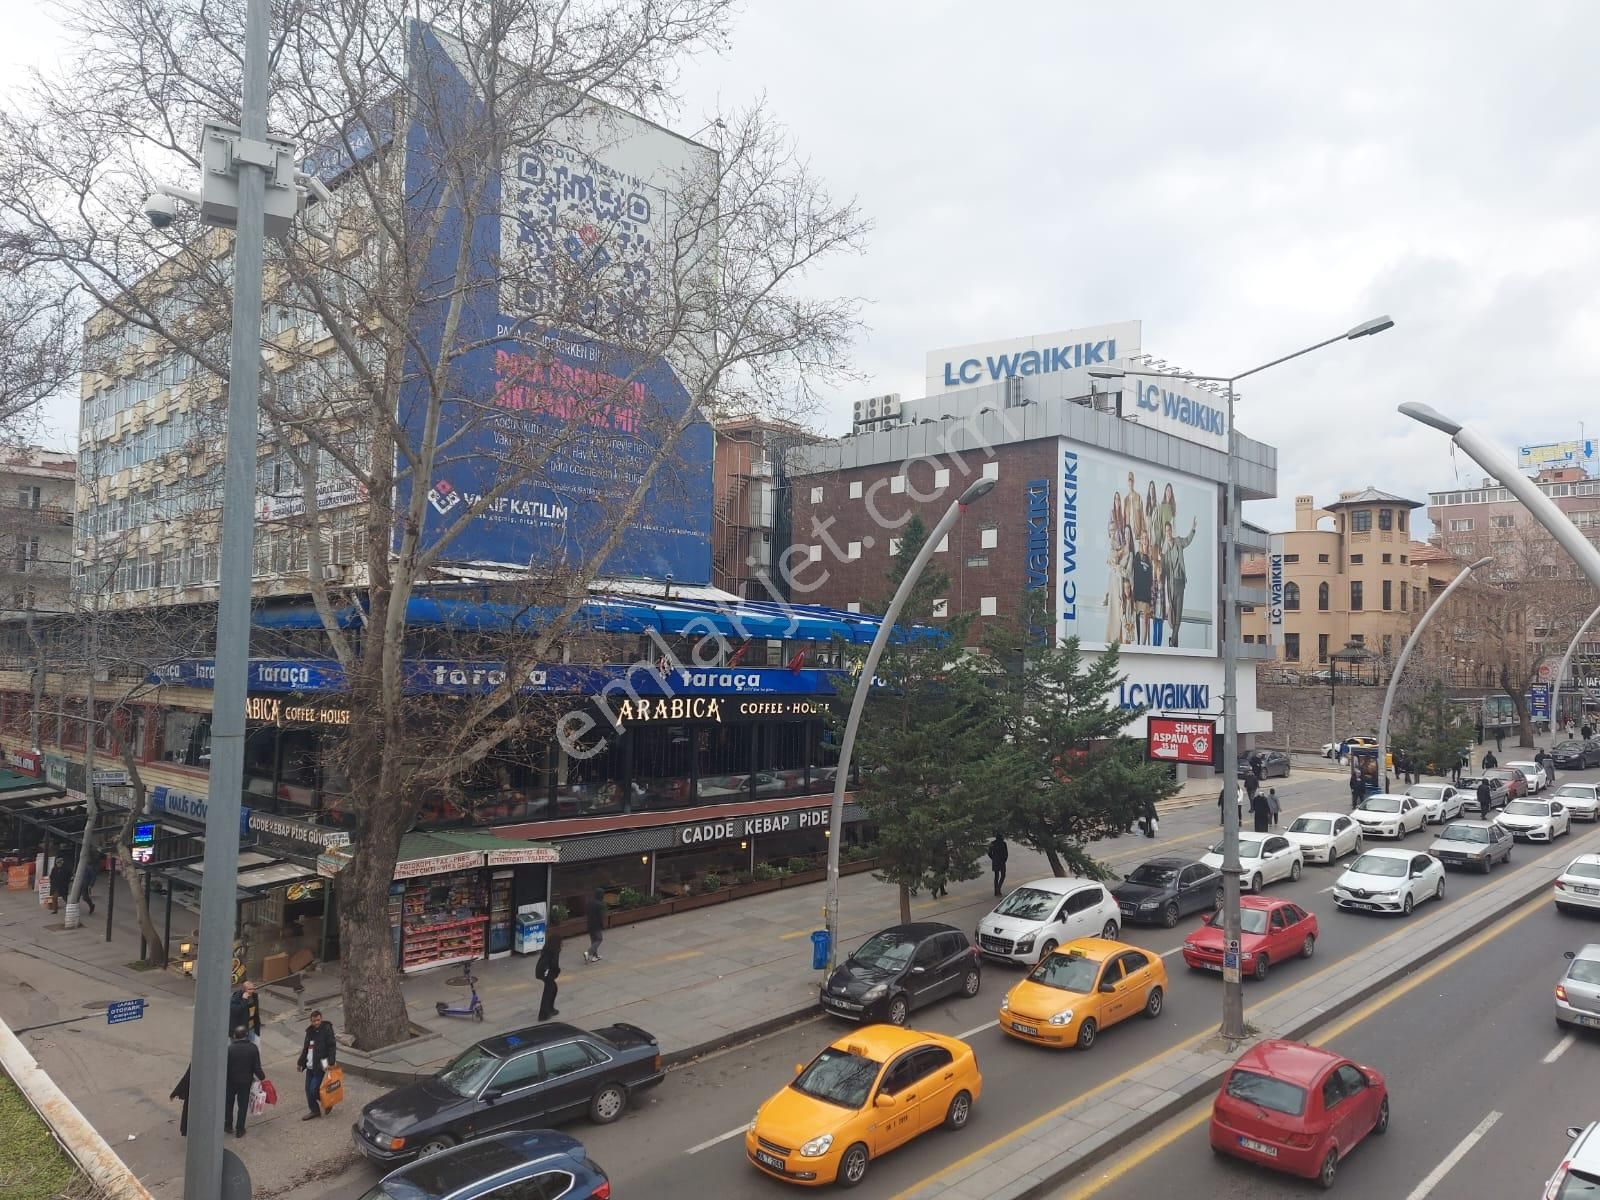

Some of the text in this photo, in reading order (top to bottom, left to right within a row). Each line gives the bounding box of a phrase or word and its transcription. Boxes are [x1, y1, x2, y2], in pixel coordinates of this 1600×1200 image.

[943, 359, 983, 387] LC
[1136, 379, 1160, 412] LC
[510, 499, 568, 521] KATILIM
[1063, 579, 1077, 621] LC
[1272, 604, 1282, 625] LC
[258, 664, 309, 688] taraça
[433, 665, 547, 685] taraa
[682, 670, 760, 691] taraça
[1120, 682, 1143, 710] LC
[285, 707, 315, 722] COFFEE
[616, 697, 722, 726] ARABICA
[740, 703, 783, 714] COFFEE
[1153, 732, 1190, 744] ASPAVA
[249, 816, 269, 832] CADDE
[682, 810, 829, 844] CADDE KEBAP PİDE
